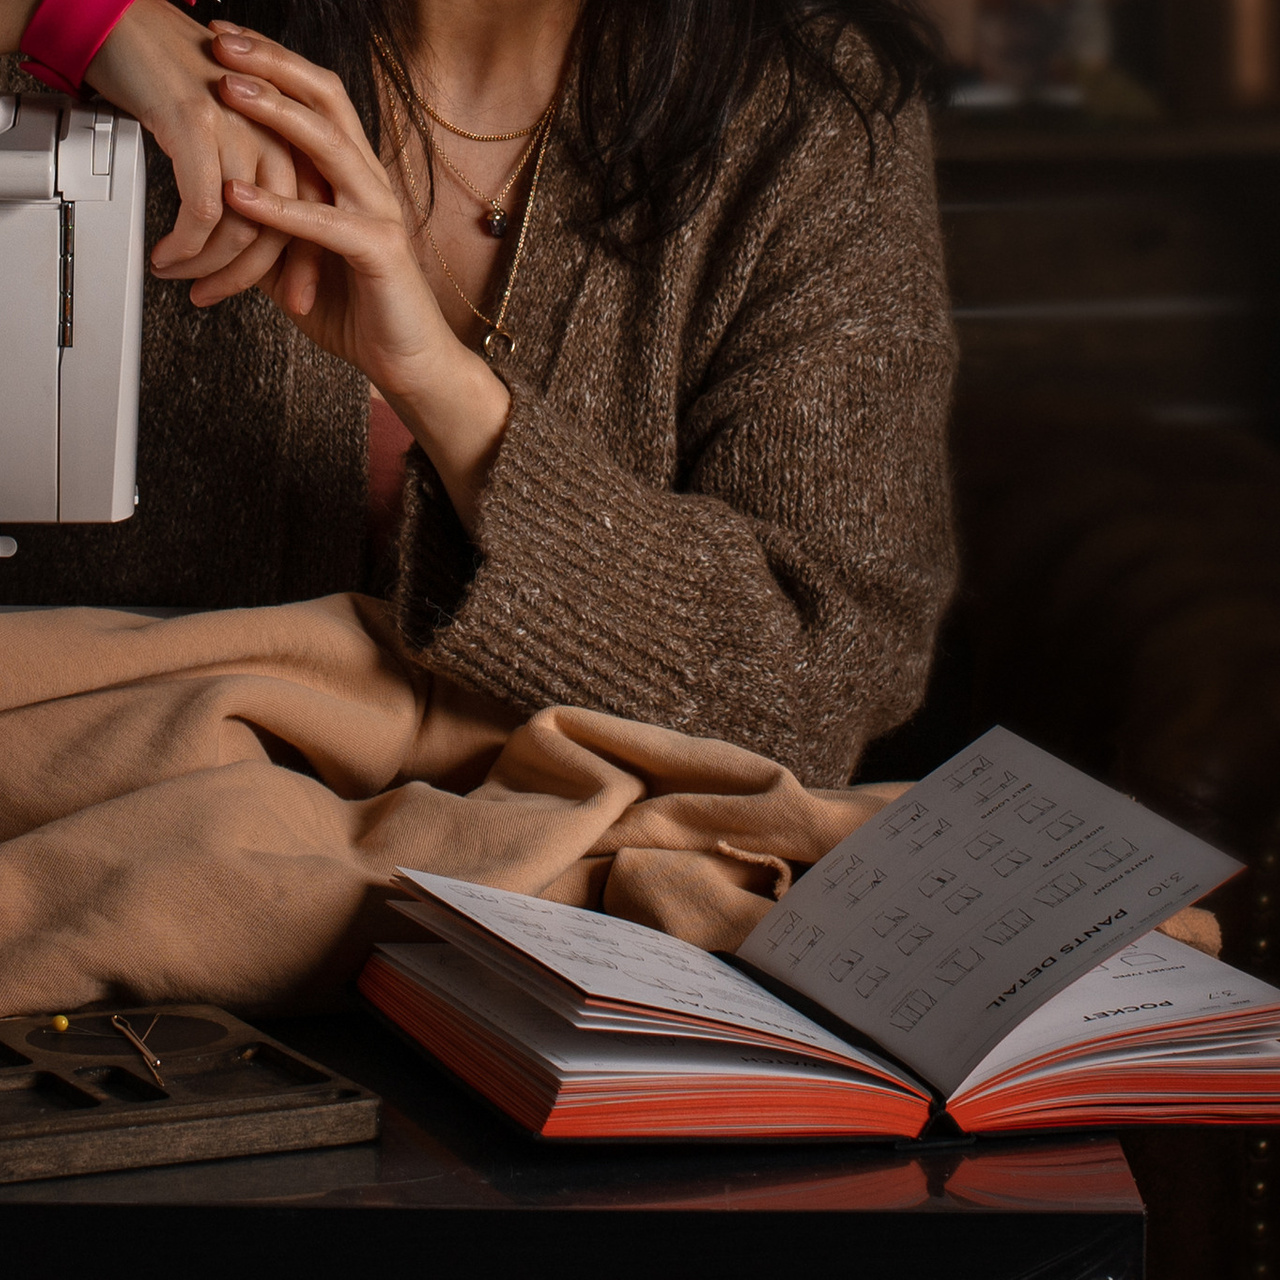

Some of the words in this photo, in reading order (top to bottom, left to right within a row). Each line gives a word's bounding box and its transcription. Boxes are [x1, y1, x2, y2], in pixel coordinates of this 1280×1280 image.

[1010, 782, 1032, 799] BELT
[979, 797, 1010, 820] LOOPS
[1083, 824, 1105, 840] SIDE
[1041, 838, 1083, 868] POCKETS
[1123, 853, 1155, 876] PANTS
[1091, 873, 1123, 897] FRONT
[1146, 870, 1184, 899] 3.10
[1058, 907, 1128, 956] PANTS
[1112, 971, 1145, 979] TYPES
[1147, 965, 1186, 975] POCKET
[986, 955, 1058, 1012] DETAIL
[1083, 1000, 1174, 1022] POCKET
